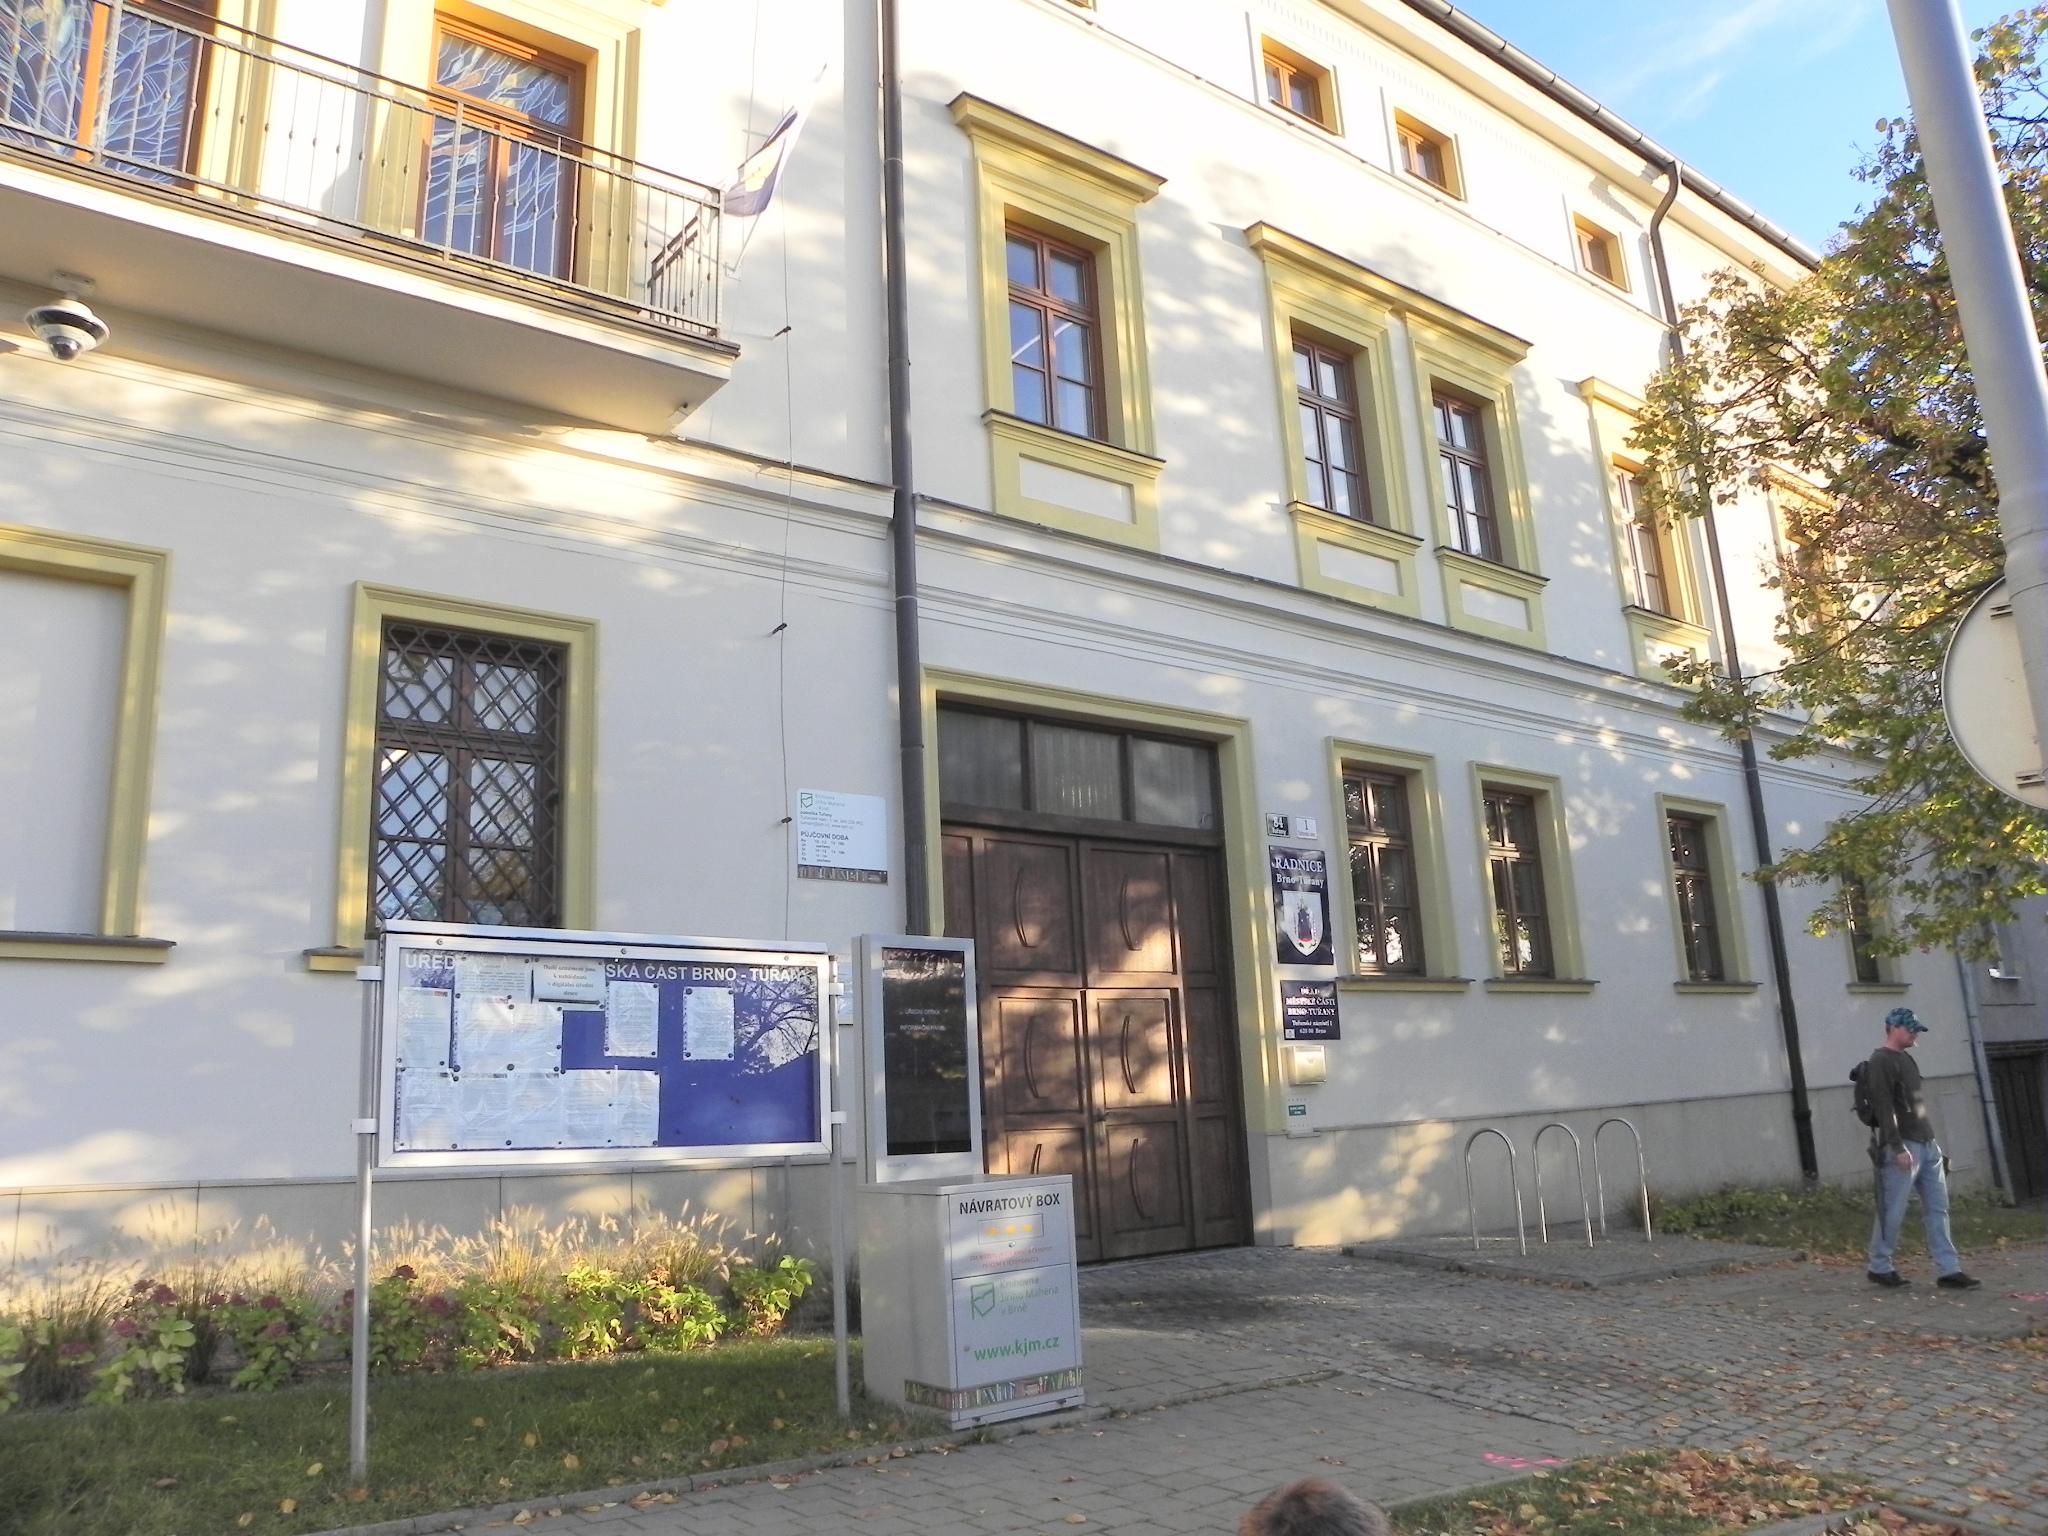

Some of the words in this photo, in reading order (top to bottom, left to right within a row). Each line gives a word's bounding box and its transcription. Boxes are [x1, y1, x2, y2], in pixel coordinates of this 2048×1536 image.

[1273, 816, 1284, 829] 84
[1274, 856, 1323, 873] RADNICE
[644, 963, 687, 980] ČÁST
[692, 967, 737, 981] BRNO
[960, 1193, 1034, 1215] NÁVRATOVÝ
[1036, 1193, 1060, 1207] BOX
[974, 1337, 1060, 1361] www.kjm.cz
